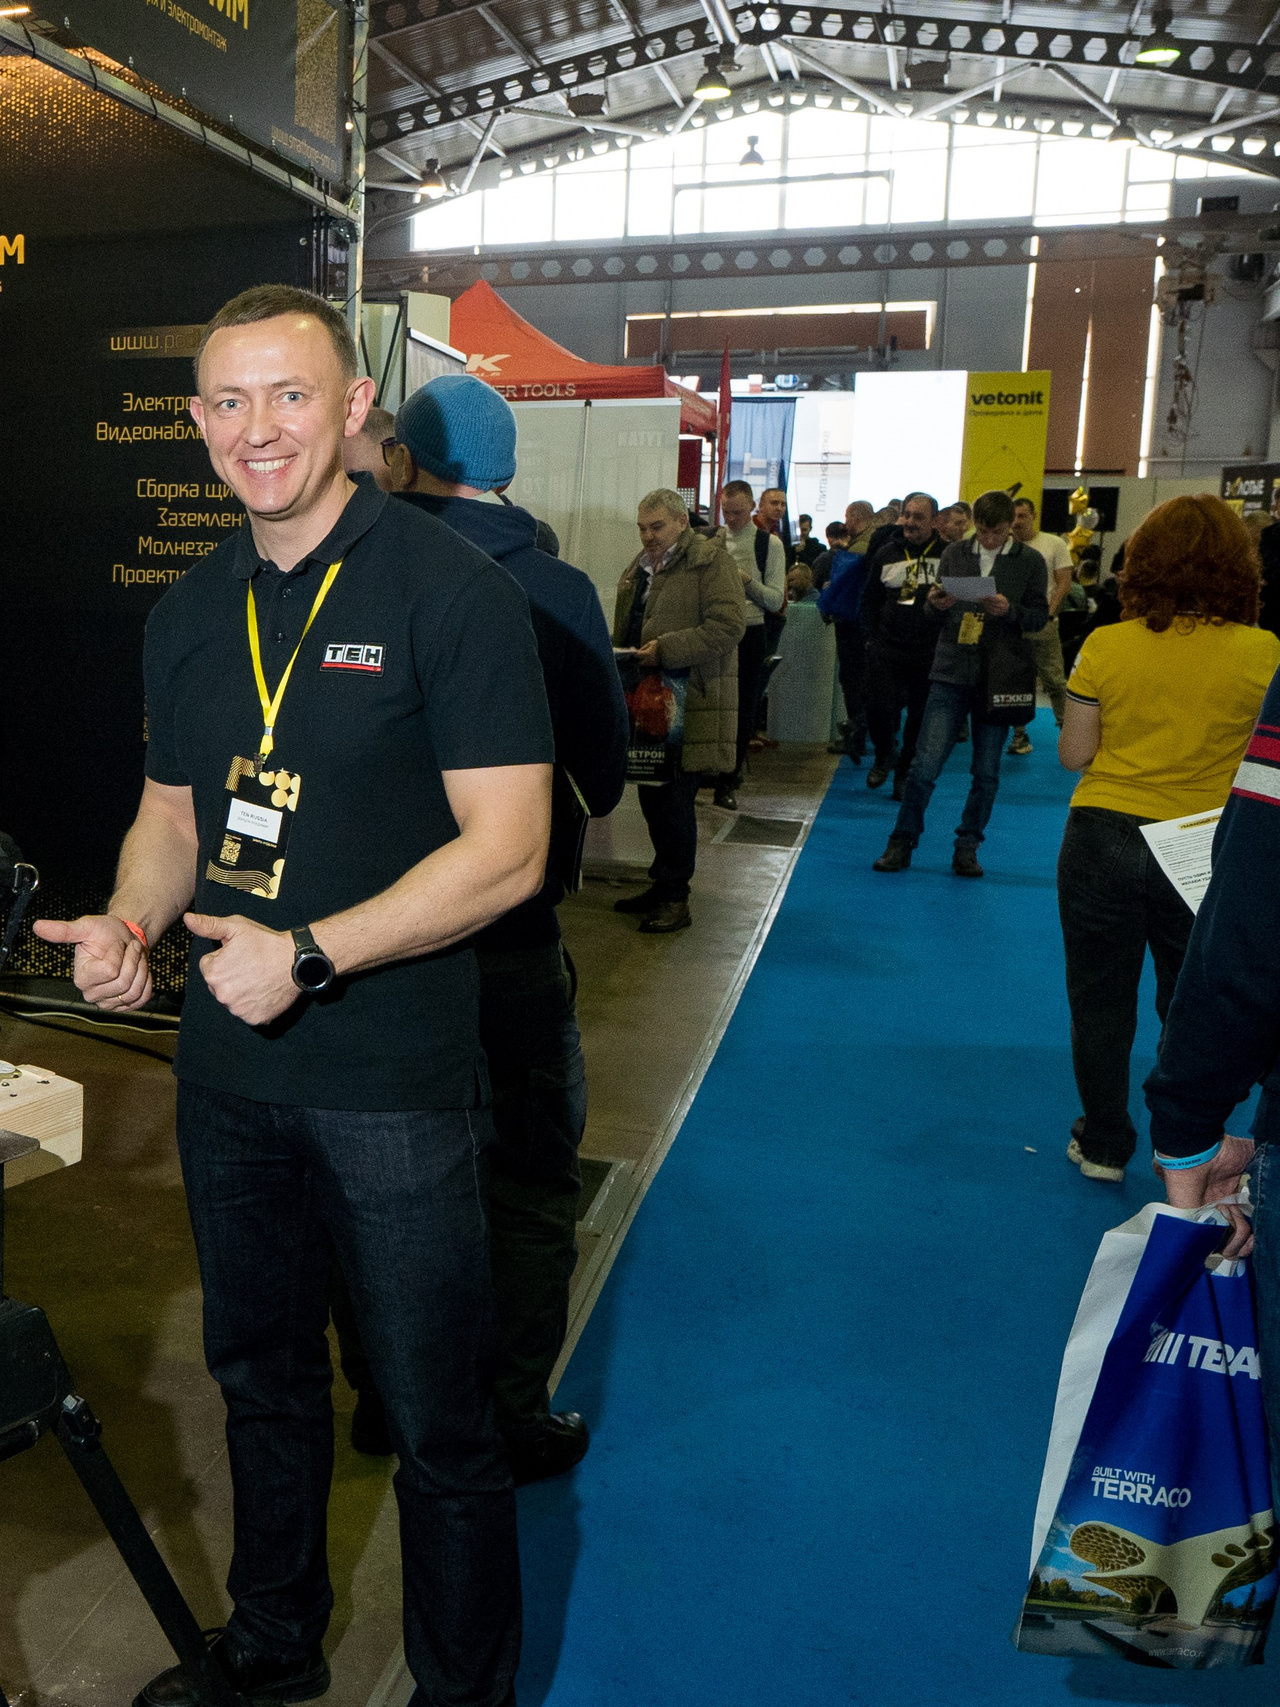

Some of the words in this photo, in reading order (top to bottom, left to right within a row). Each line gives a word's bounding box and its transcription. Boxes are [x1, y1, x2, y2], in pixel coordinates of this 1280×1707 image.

[521, 383, 577, 398] TOOLS
[971, 391, 1043, 405] vetonit
[137, 479, 199, 502] Сборка
[157, 508, 246, 527] Заземлен
[138, 536, 218, 555] Молнеза
[1092, 1466, 1122, 1479] BUILT
[1124, 1470, 1156, 1485] WITH
[1091, 1477, 1192, 1508] TERRACO
